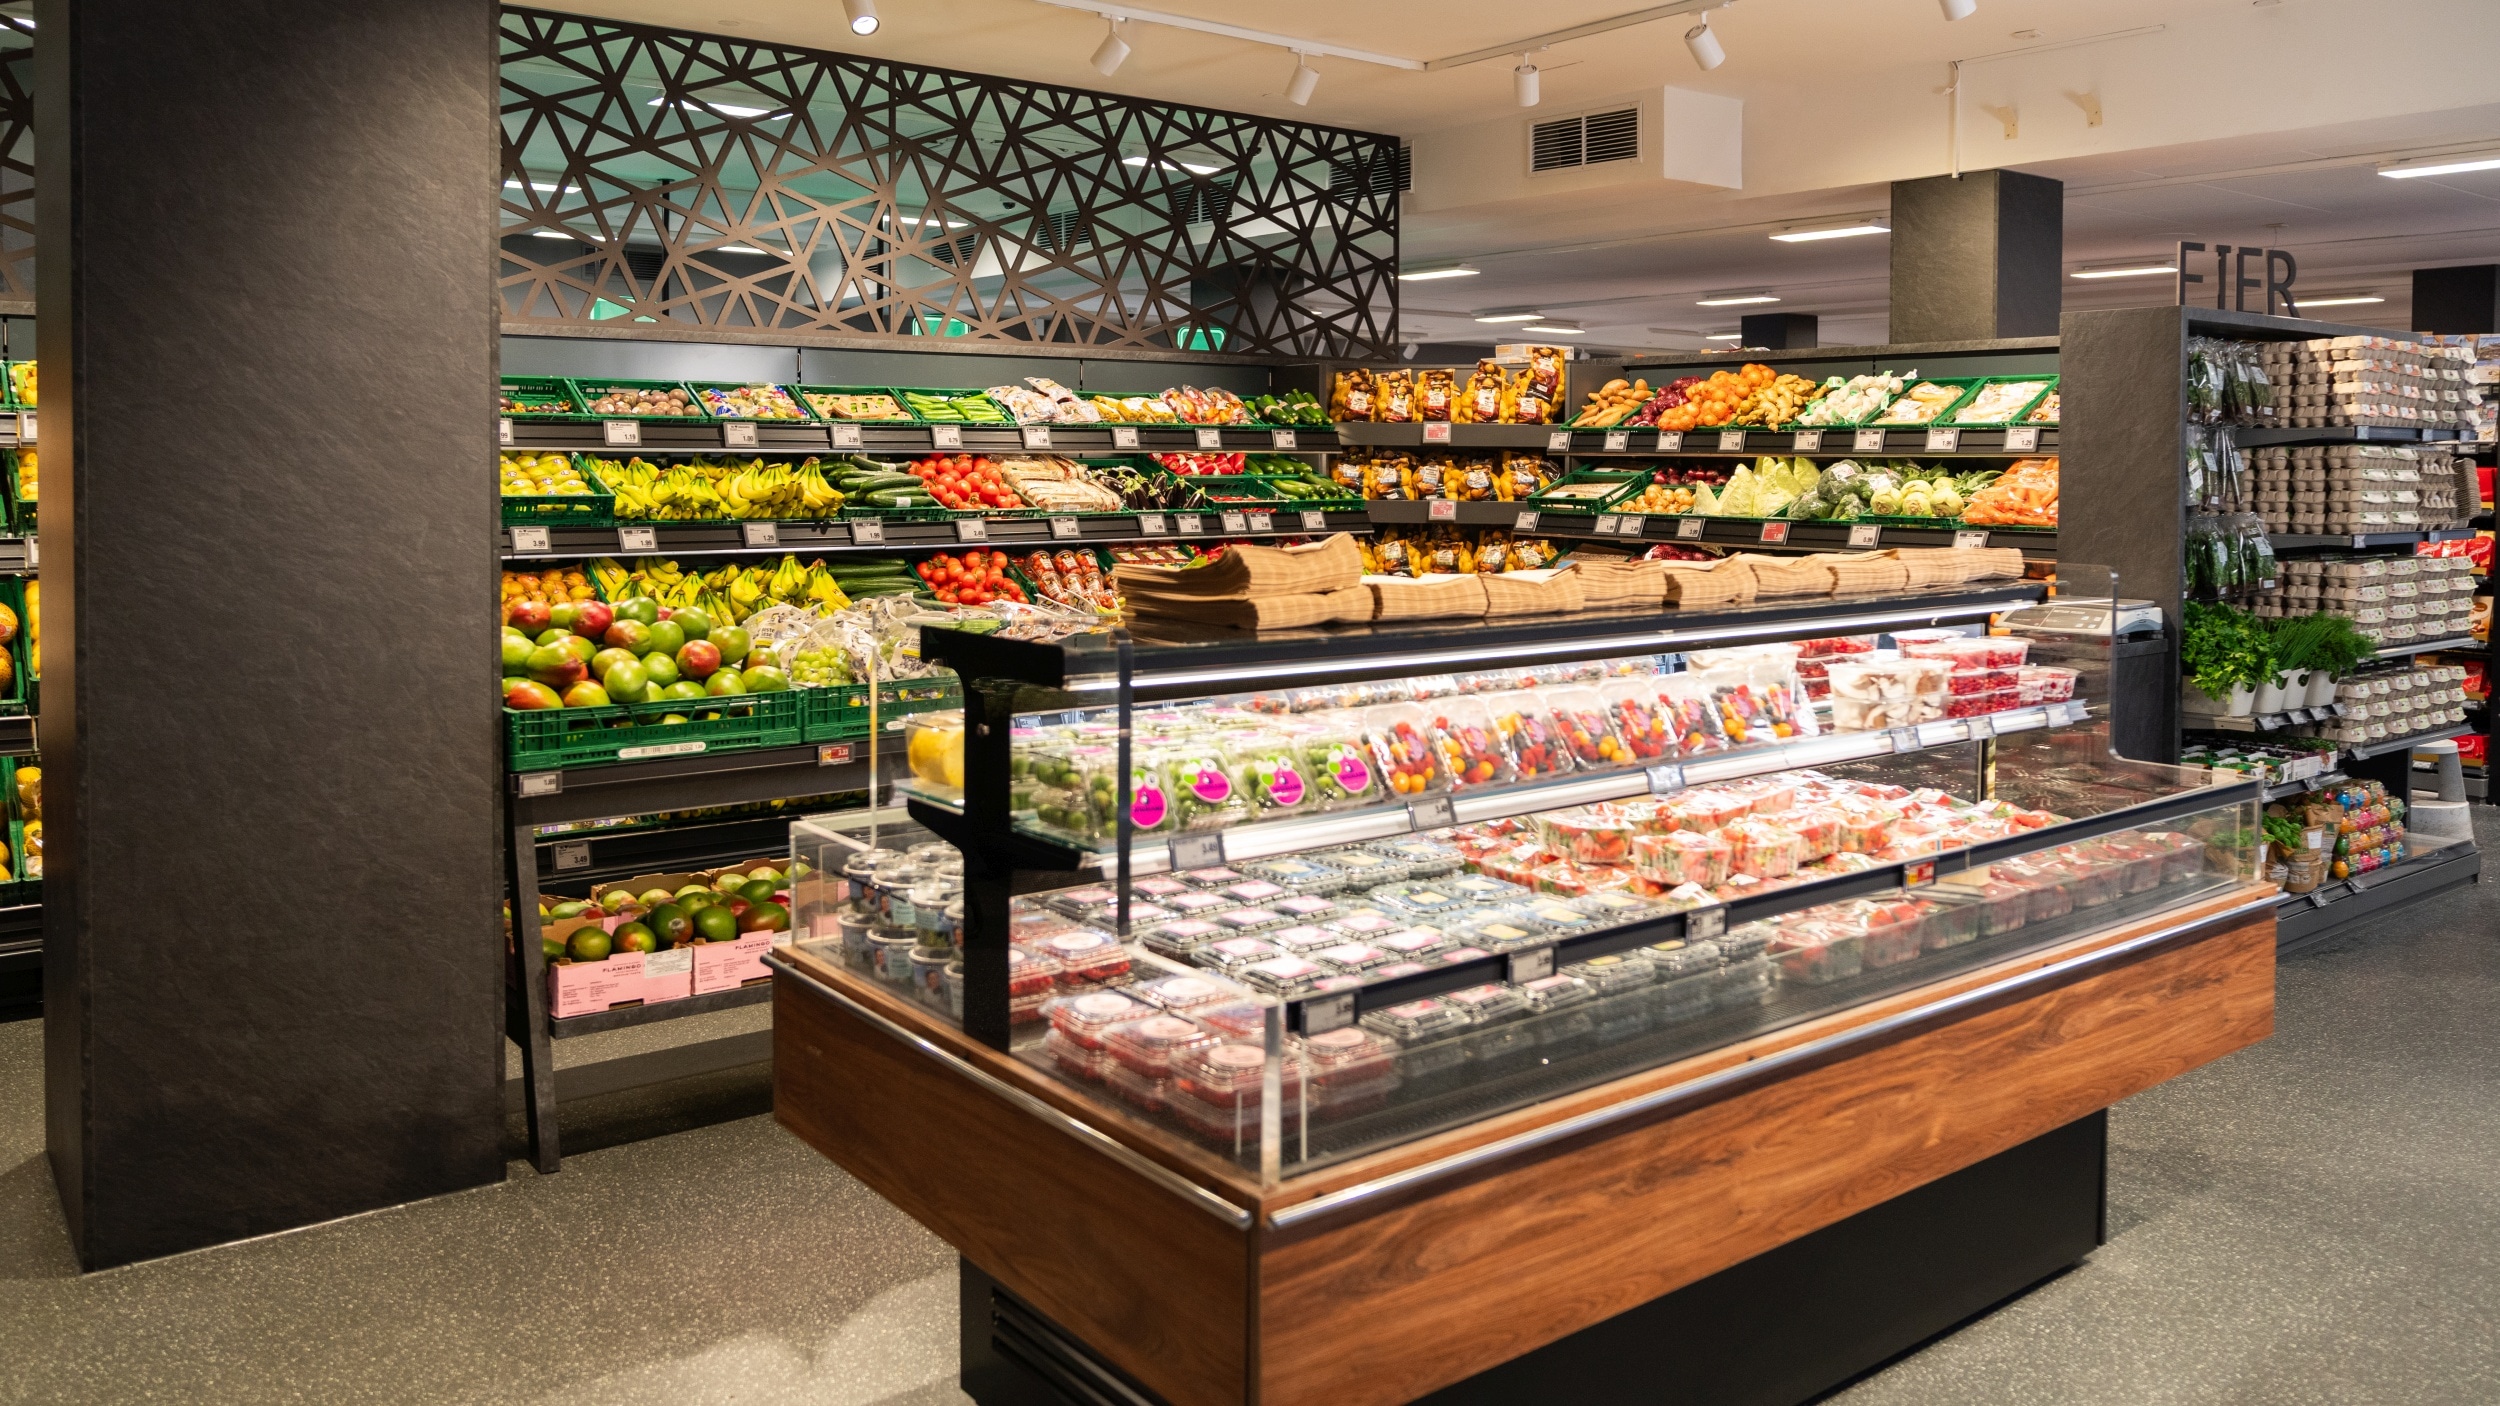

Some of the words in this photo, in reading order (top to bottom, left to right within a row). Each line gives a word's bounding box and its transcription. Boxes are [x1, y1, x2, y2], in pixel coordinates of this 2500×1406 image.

[574, 855, 588, 864] 3.49
[735, 939, 771, 950] FLAMINGO
[602, 963, 642, 973] FLAMINGO
